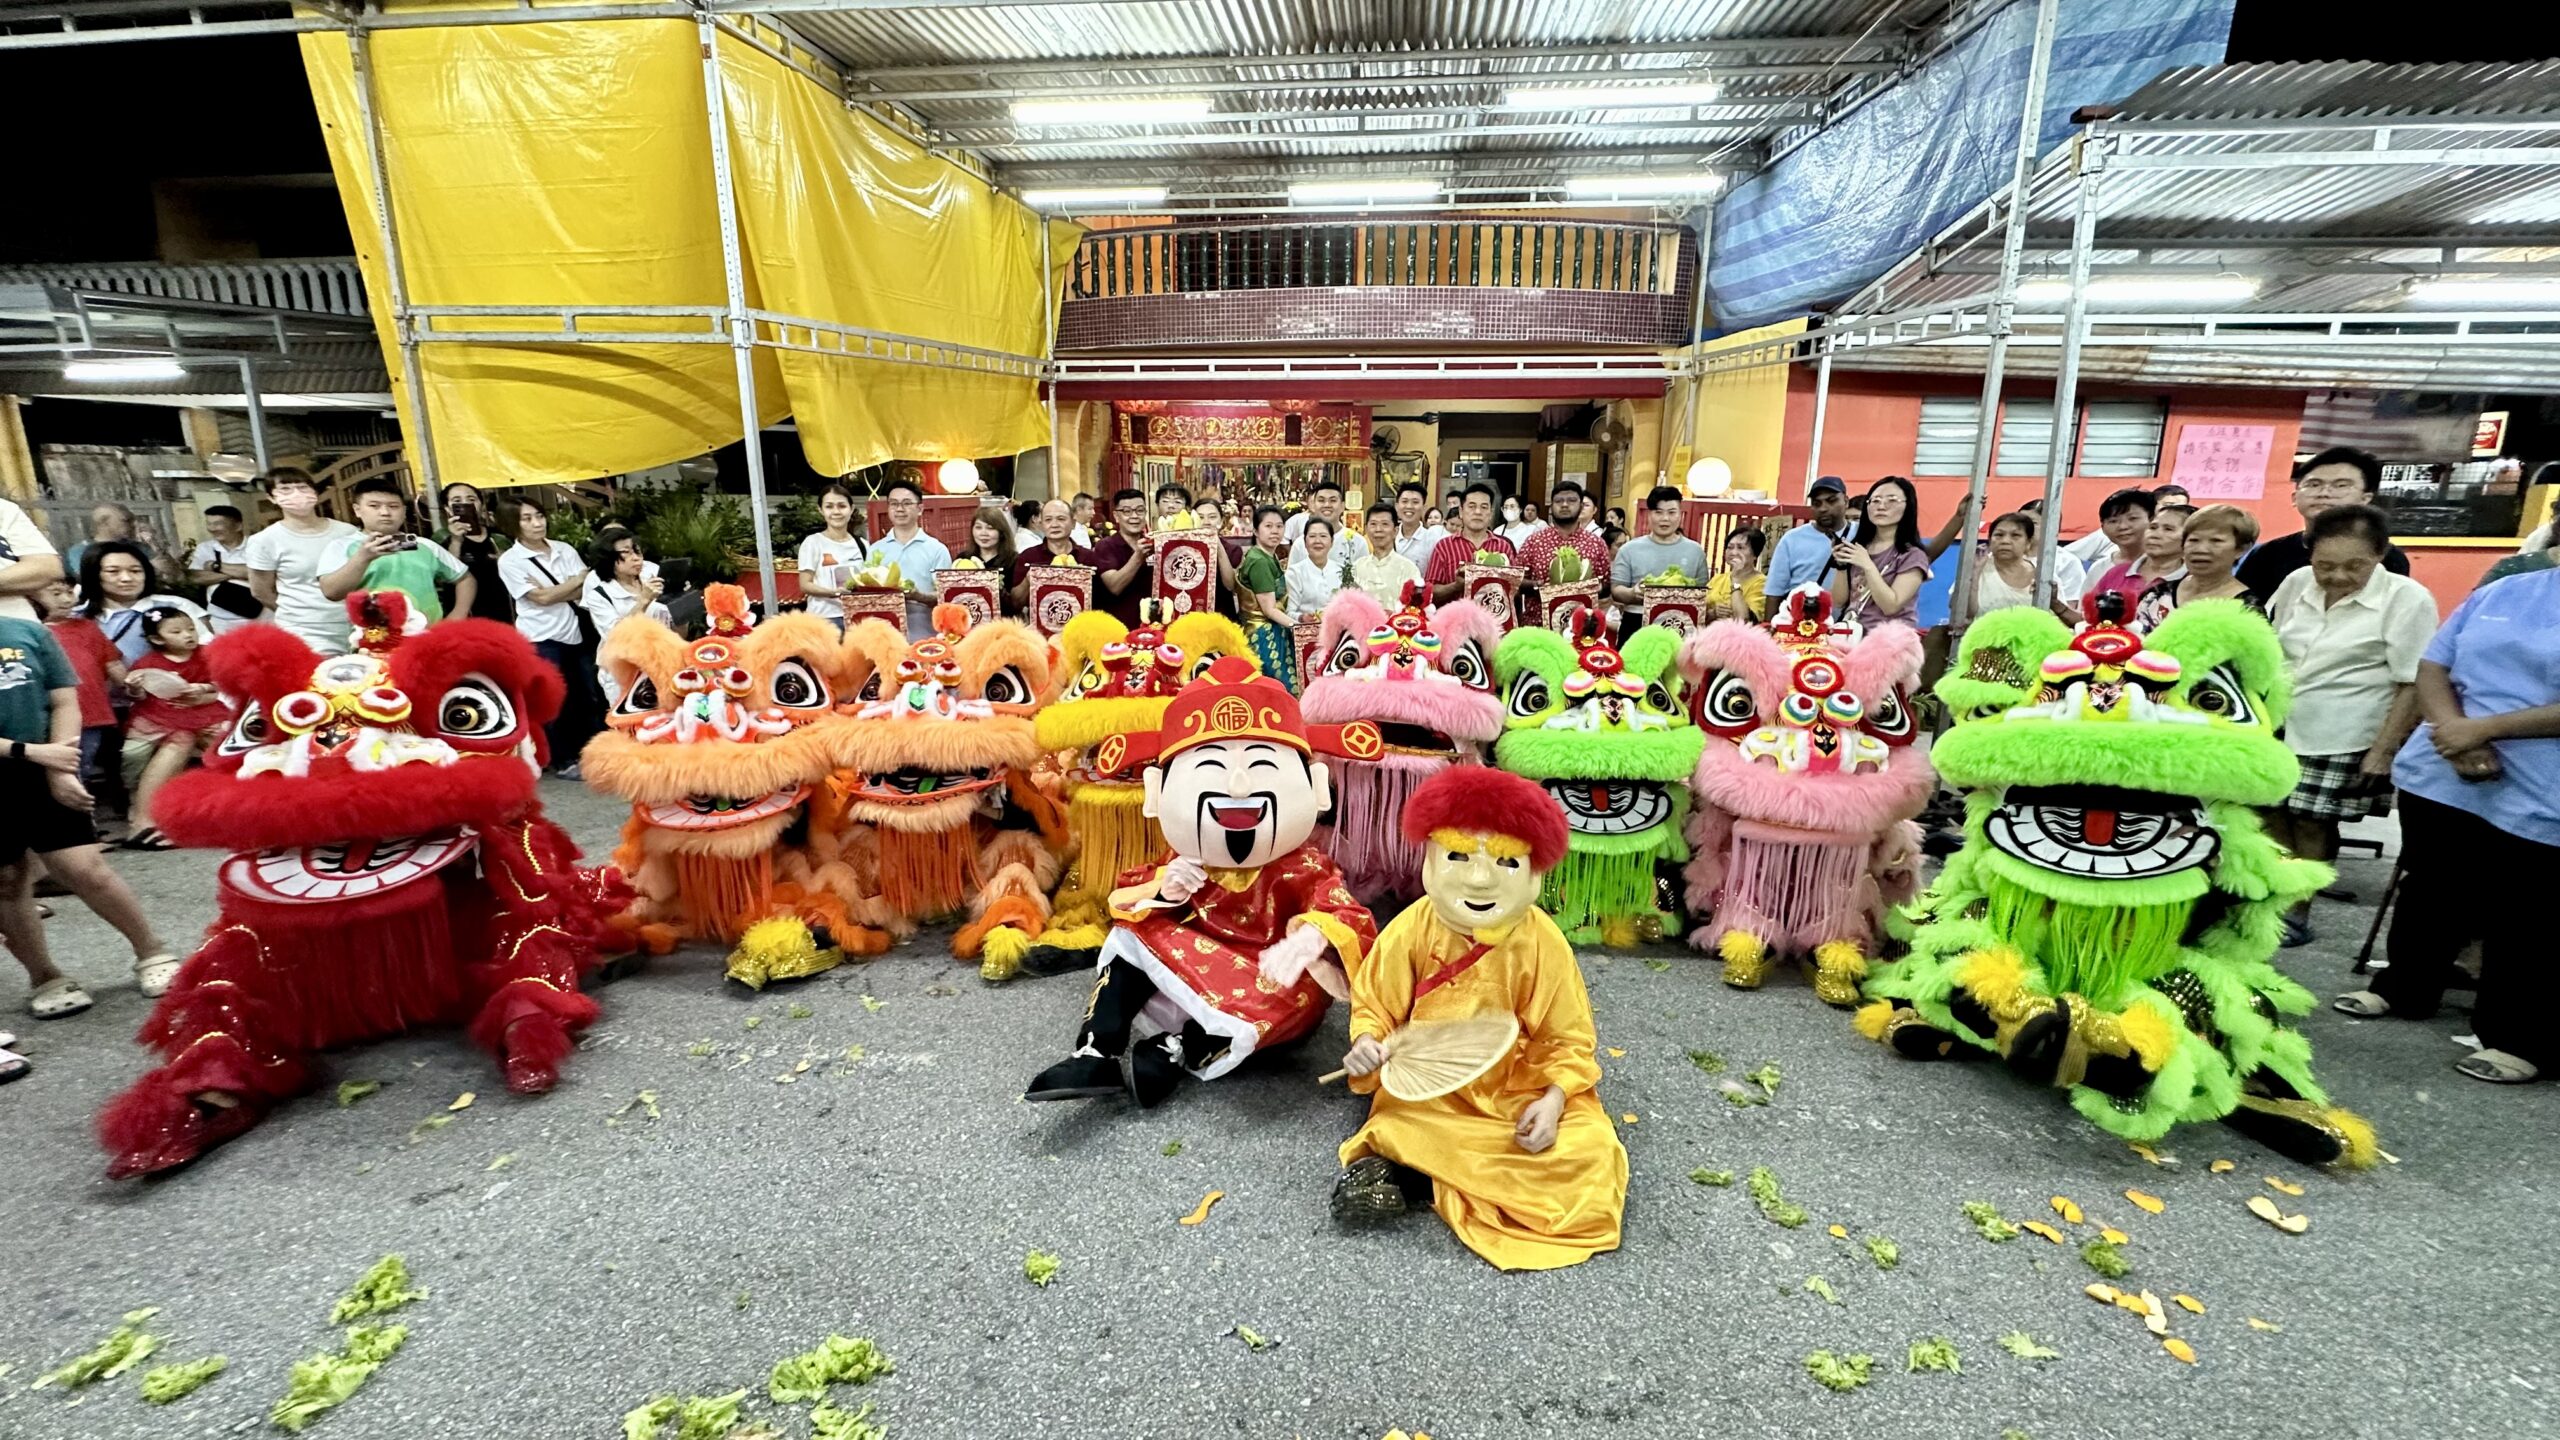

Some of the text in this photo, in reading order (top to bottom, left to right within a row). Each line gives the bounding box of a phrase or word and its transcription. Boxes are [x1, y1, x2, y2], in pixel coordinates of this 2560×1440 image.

[1172, 554, 1197, 582] 福
[1048, 599, 1073, 625] 福
[1215, 698, 1251, 731] 福
